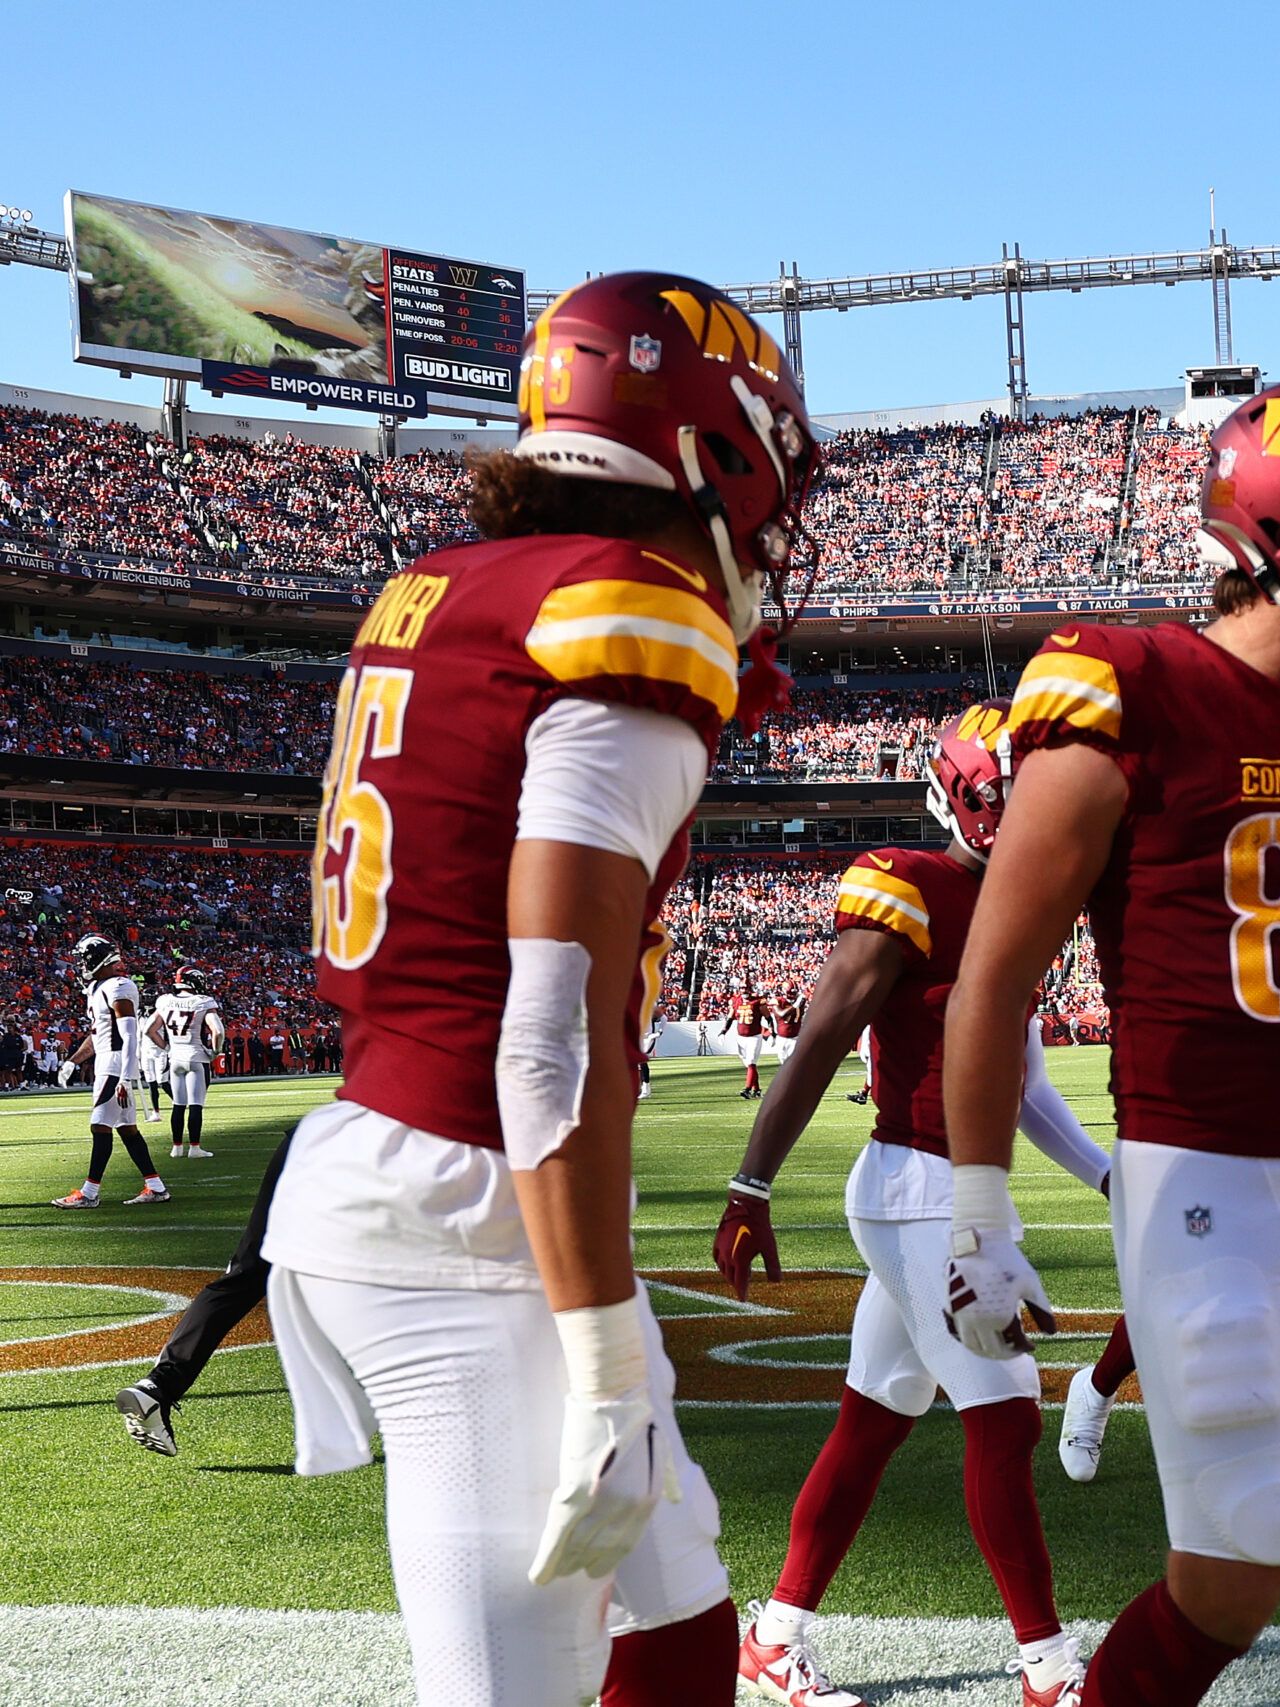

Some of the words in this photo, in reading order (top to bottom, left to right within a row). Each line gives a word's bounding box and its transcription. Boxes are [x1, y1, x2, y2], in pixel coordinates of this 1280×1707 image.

[393, 257, 439, 272] OFFENSIVE
[393, 265, 434, 282] STATS
[393, 282, 439, 297] PENALTIES
[459, 293, 466, 302] 4
[393, 297, 414, 308] PEN.
[414, 300, 444, 313] YARDS
[457, 307, 470, 316] 40
[498, 314, 511, 324] 36
[394, 312, 446, 328] TURNOVERS
[461, 322, 467, 331] 0
[503, 330, 508, 338] 1
[394, 328, 412, 338] TIME
[414, 331, 423, 339] OF
[424, 333, 446, 343] POSS.
[451, 336, 478, 348] 20:06
[494, 342, 518, 353] 12:20
[408, 358, 450, 379] BUD
[452, 365, 508, 387] LIGHT
[15, 389, 29, 399] 515
[270, 375, 363, 402] EMPOWER
[367, 389, 416, 409] FIELD
[237, 420, 250, 429] 516
[452, 433, 465, 441] 517
[5, 552, 55, 571] ATWATER
[96, 569, 109, 579] 77
[112, 570, 191, 589] MECKLENBURG
[251, 587, 264, 597] 20
[265, 588, 310, 601] WRIGHT
[941, 605, 952, 614] 87
[956, 605, 965, 614] R.
[967, 603, 1021, 614] JACKSON
[1070, 602, 1081, 611] 87
[1088, 600, 1129, 610] TAYLOR
[1178, 598, 1185, 607] 7
[763, 608, 794, 618] SMIH
[842, 607, 879, 617] PHIPPS
[72, 646, 87, 655] 317
[213, 839, 227, 848] 110
[166, 1010, 195, 1036] 47
